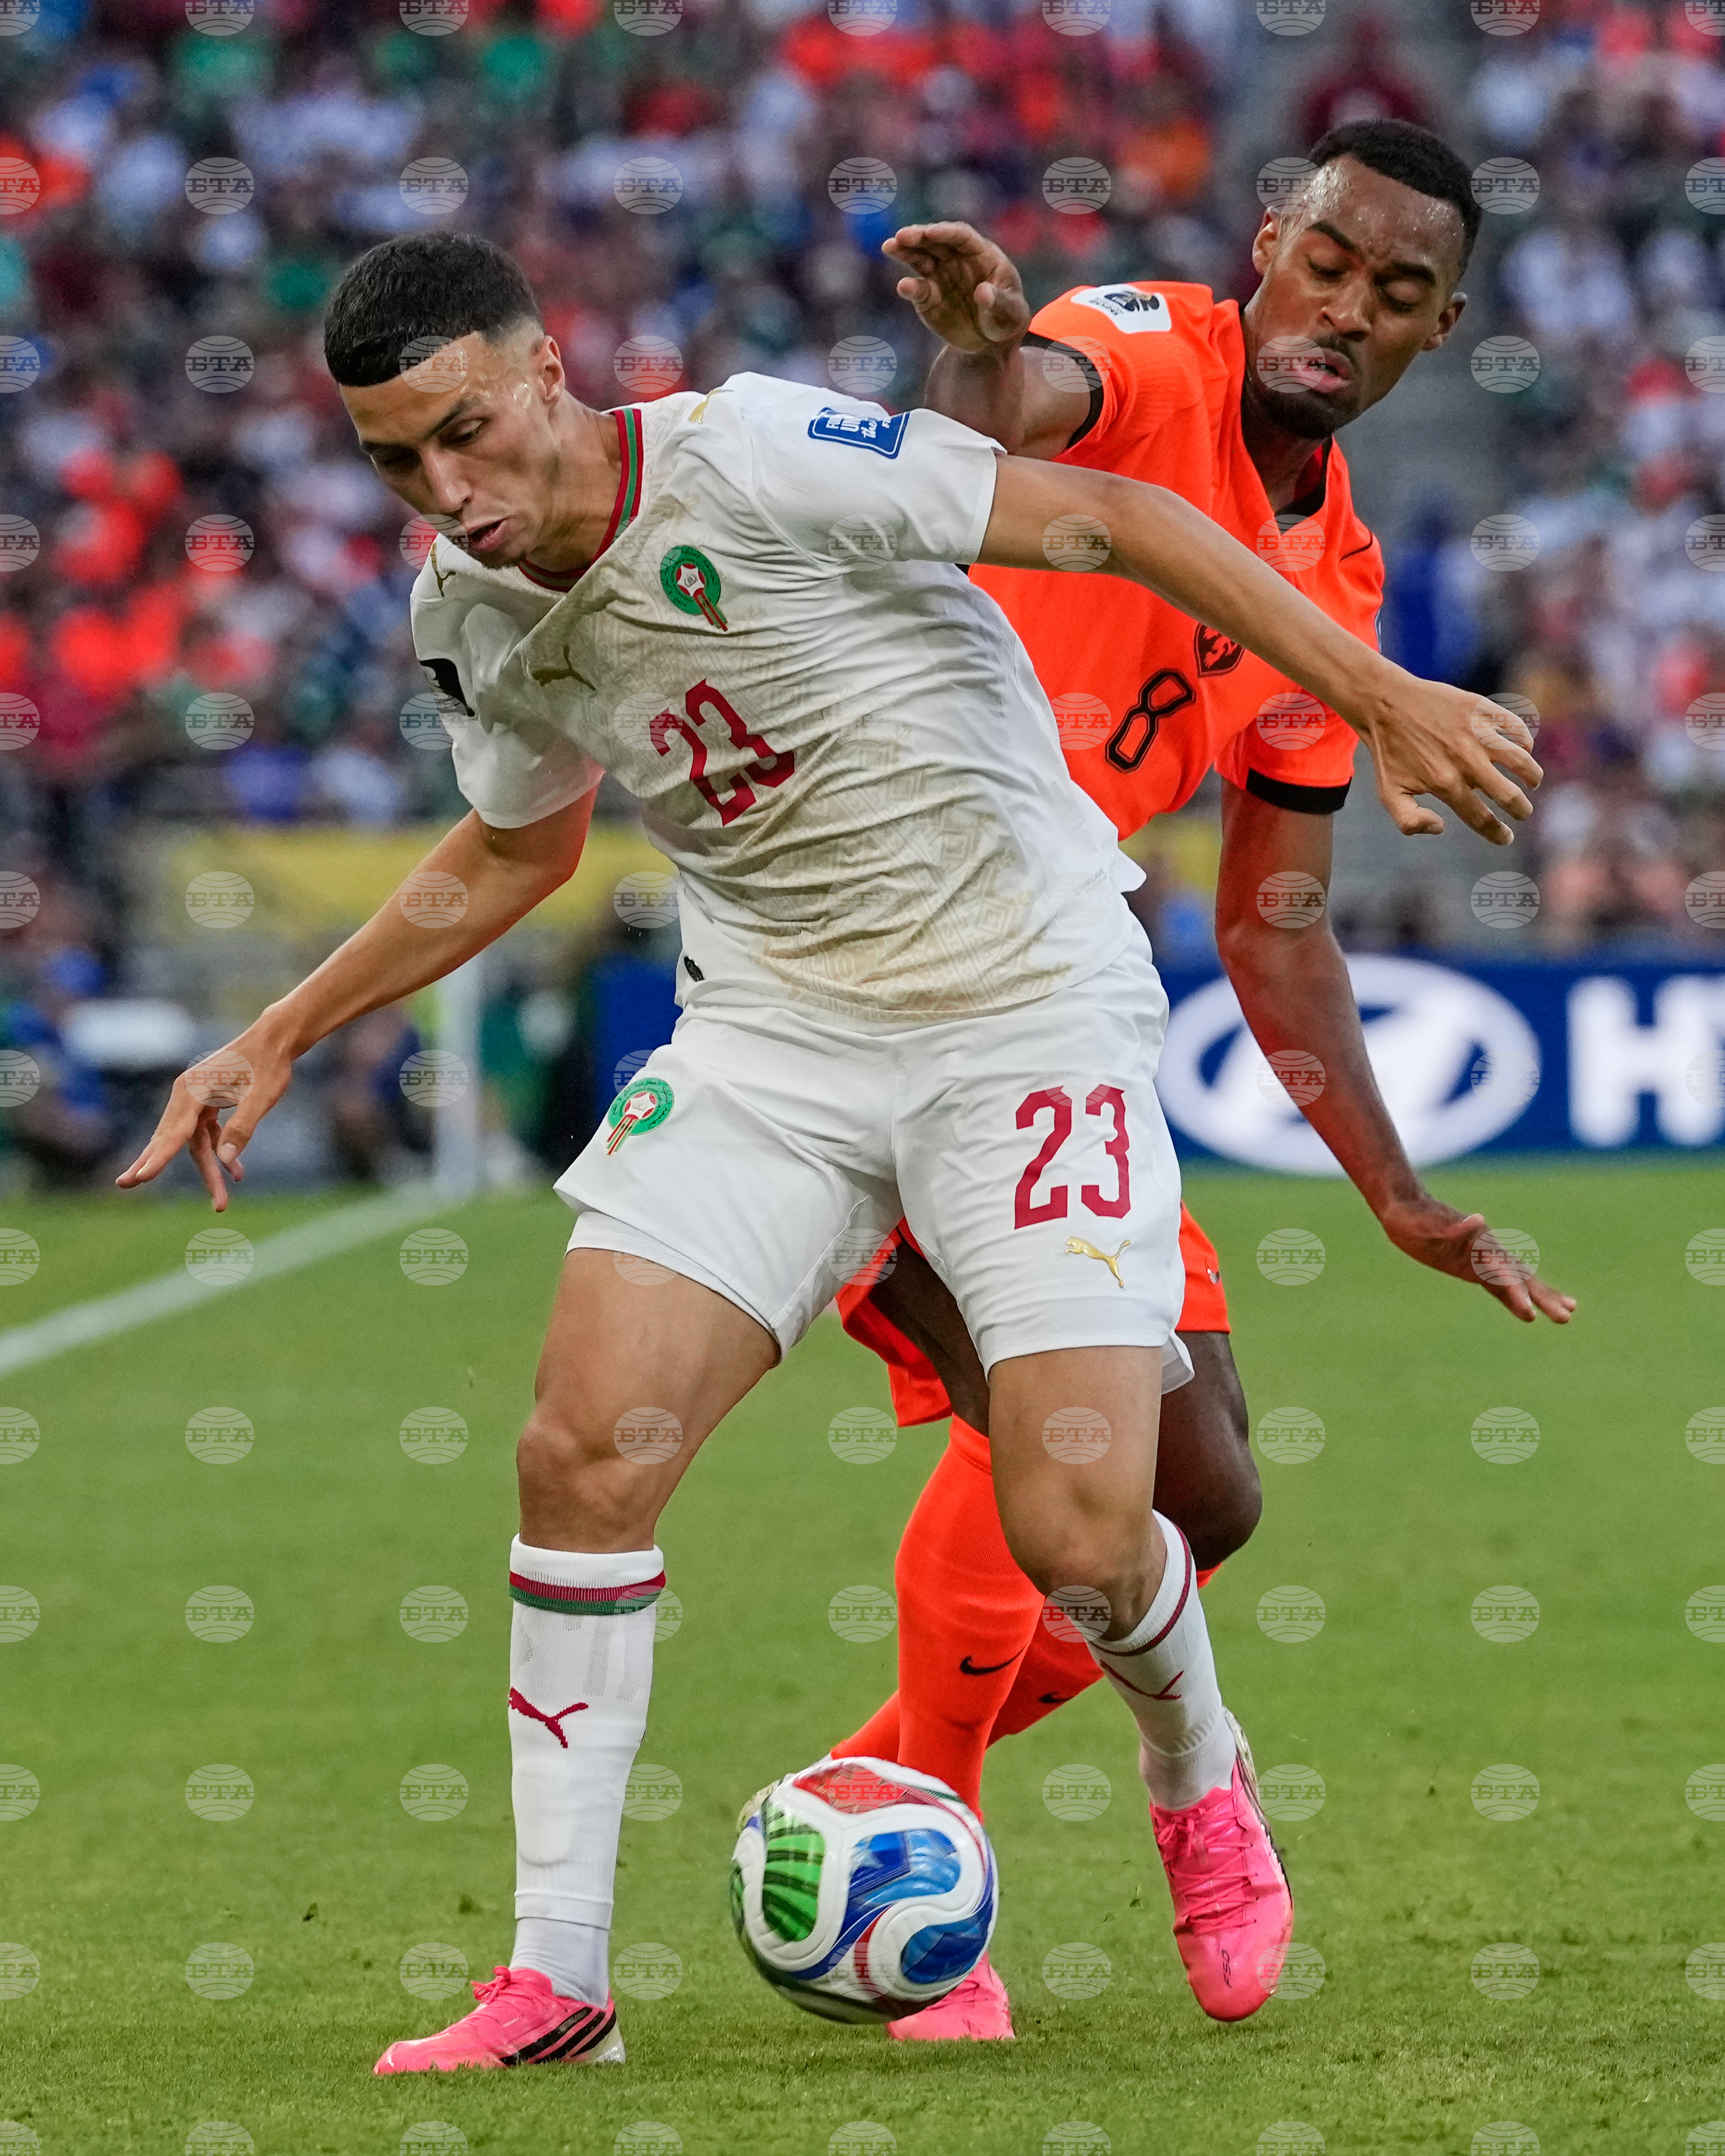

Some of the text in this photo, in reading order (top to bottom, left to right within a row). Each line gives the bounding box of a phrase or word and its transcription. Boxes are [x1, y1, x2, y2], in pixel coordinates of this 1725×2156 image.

[650, 678, 795, 825] 23
[1105, 668, 1196, 774] 8
[1565, 973, 1725, 1149] H
[1014, 1084, 1131, 1229] 23
